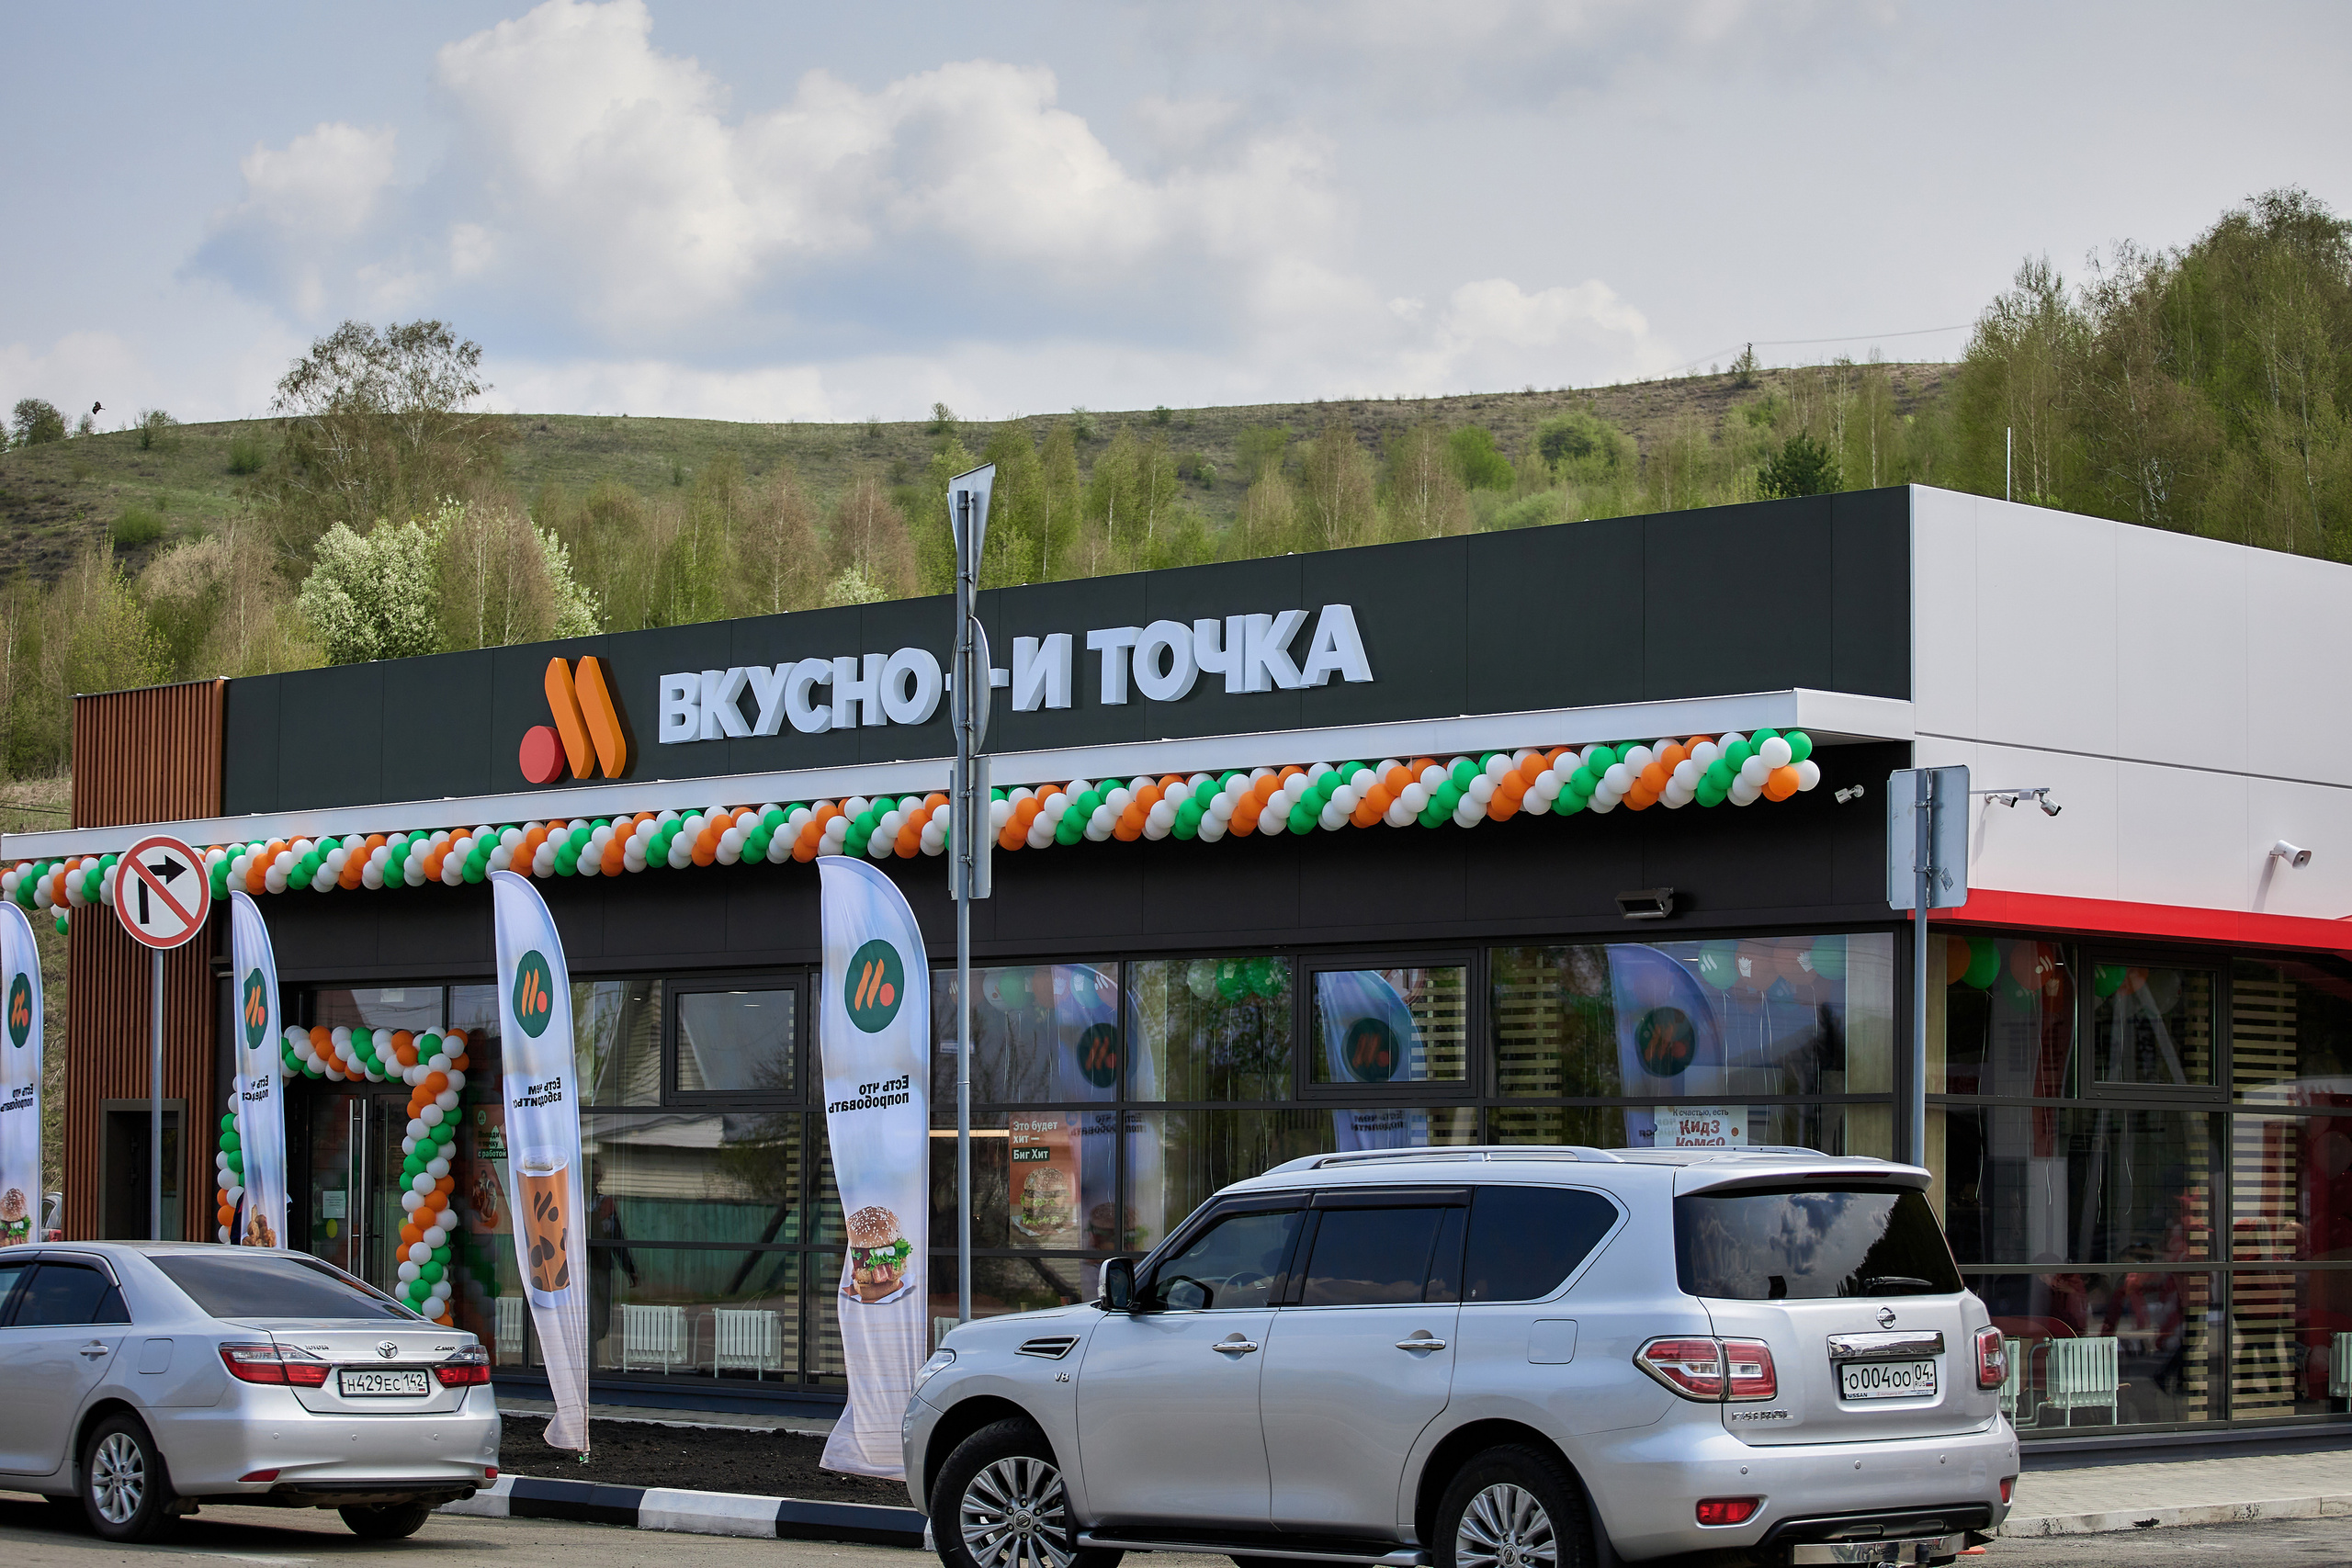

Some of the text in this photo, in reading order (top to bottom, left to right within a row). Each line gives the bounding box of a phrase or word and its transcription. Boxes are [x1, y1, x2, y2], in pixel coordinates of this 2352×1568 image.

[659, 604, 1374, 744] ВКУСНО И ТОЧКА
[1679, 1109, 1712, 1117] счастью,
[1013, 1120, 1057, 1133] Это будет
[1013, 1135, 1029, 1144] хит
[482, 1148, 507, 1159] работой
[1013, 1148, 1048, 1160] Биг Хит
[1054, 1371, 1069, 1382] V8
[1915, 1364, 1929, 1380] 04
[403, 1373, 423, 1387] 142
[1731, 1409, 1794, 1422] PATROL
